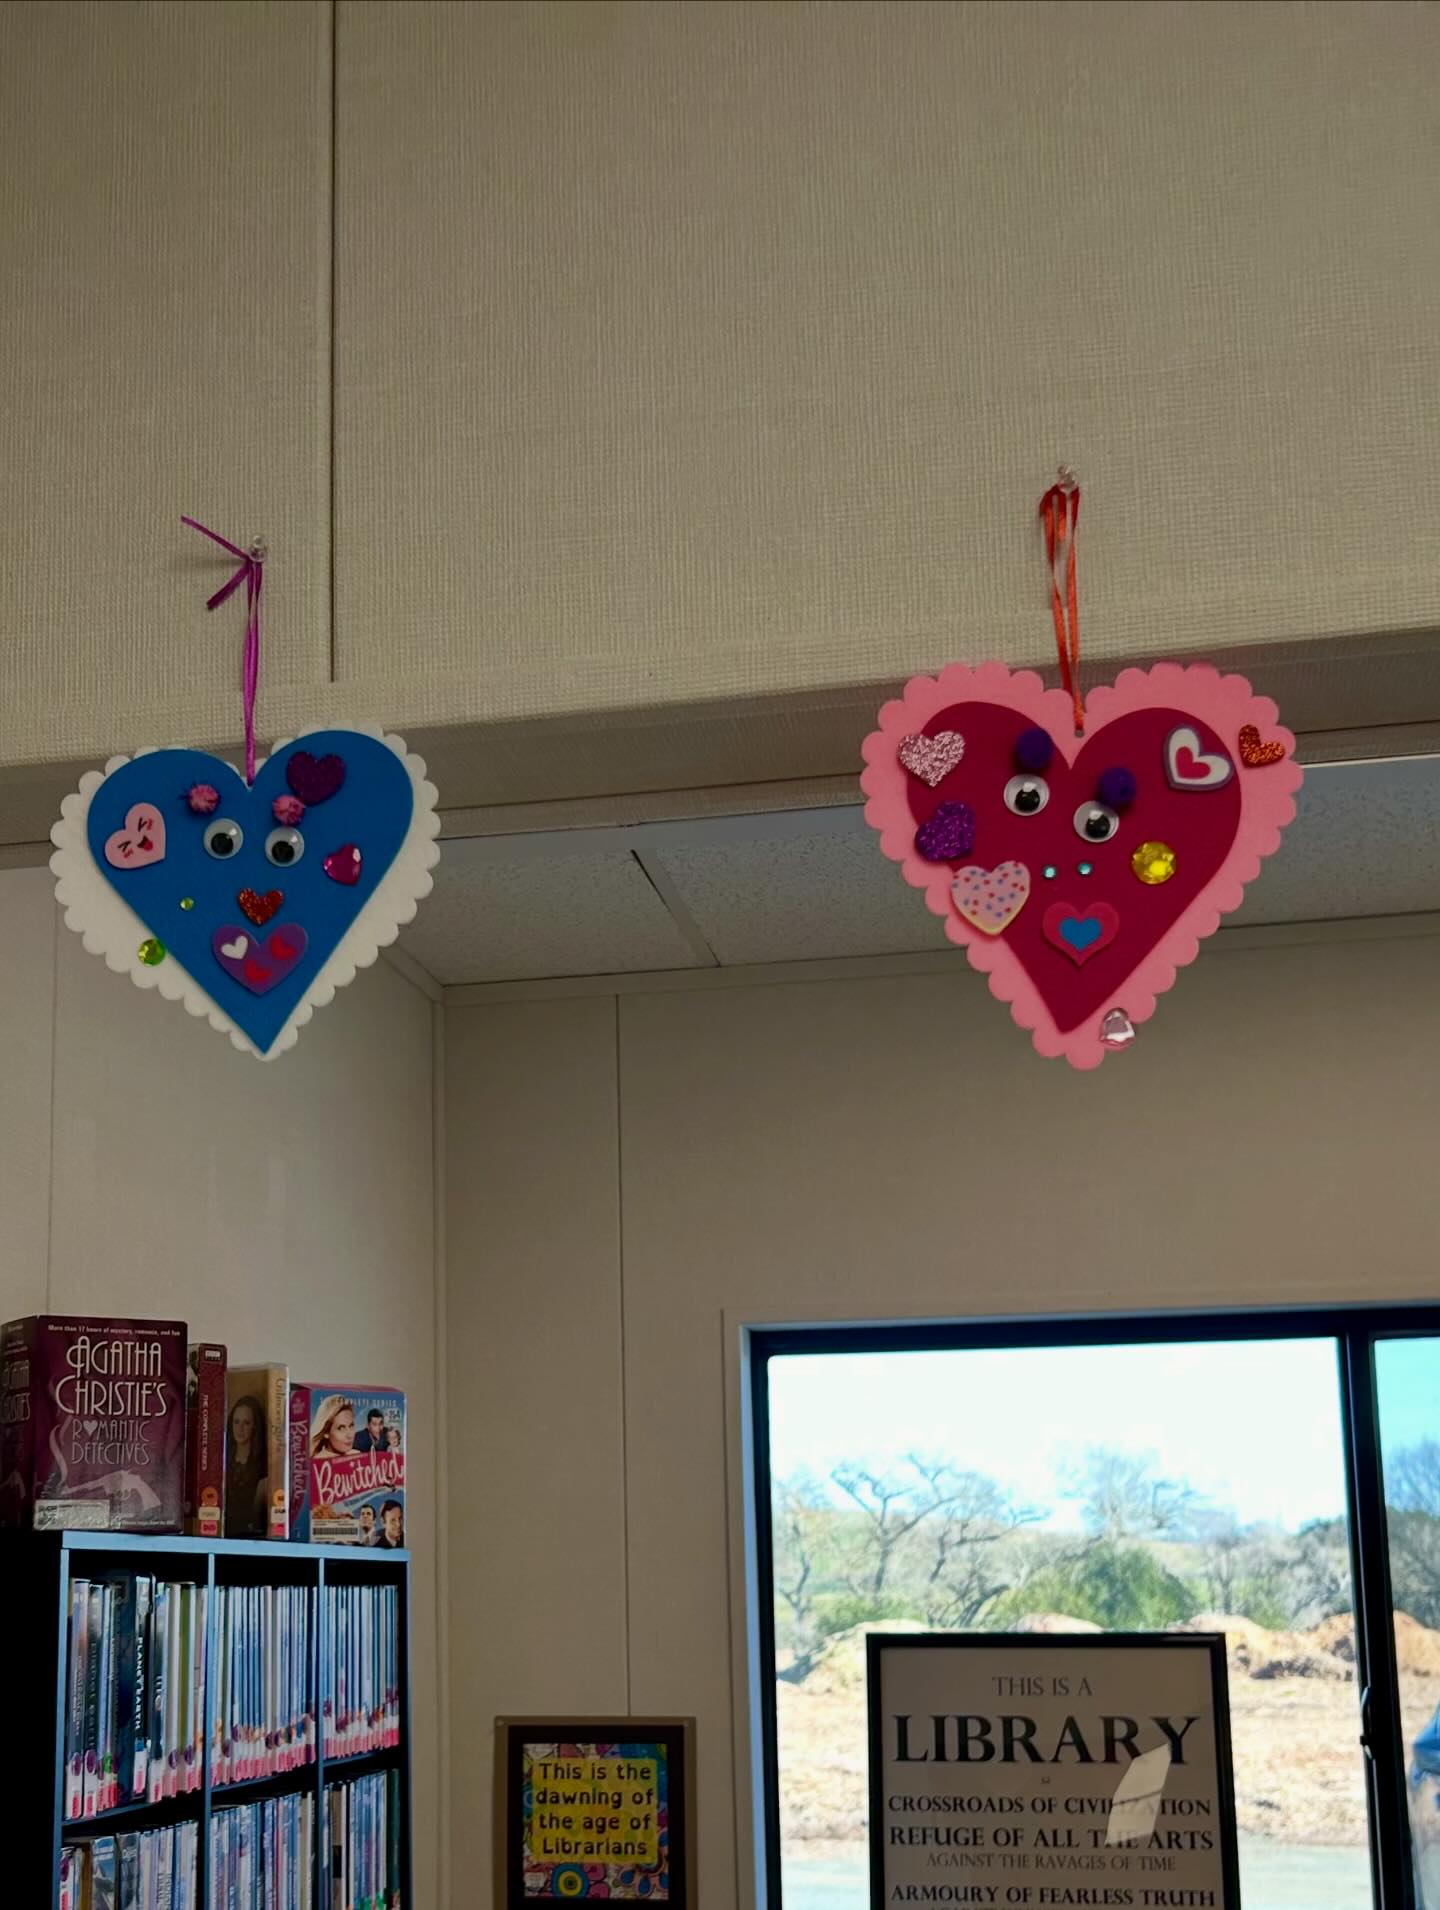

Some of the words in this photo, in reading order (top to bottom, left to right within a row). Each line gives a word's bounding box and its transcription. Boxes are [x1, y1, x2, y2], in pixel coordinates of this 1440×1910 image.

[48, 1324, 63, 1332] More
[66, 1335, 162, 1378] AGATHA
[55, 1374, 167, 1417] CHRISTIE'S
[72, 1442, 150, 1465] DETECTIVES
[290, 1419, 309, 1499] Bewitched
[313, 1443, 405, 1504] Bewitched
[992, 1676, 1044, 1697] THIS
[1052, 1676, 1070, 1697] IS
[1078, 1677, 1093, 1697] A
[892, 1714, 1201, 1765] LIBRARY
[539, 1763, 582, 1780] This
[591, 1763, 607, 1780] is
[616, 1763, 652, 1780] the
[536, 1787, 623, 1809] dawning
[631, 1788, 654, 1805] of
[888, 1795, 1024, 1814] CROSSROADS
[1031, 1796, 1058, 1815] OF
[539, 1812, 574, 1830] the
[583, 1816, 620, 1834] age
[630, 1813, 652, 1830] of
[542, 1837, 648, 1855] Librarians
[890, 1826, 985, 1847] REFUGE
[992, 1827, 1025, 1848] OF
[1033, 1827, 1080, 1848] ALL
[1149, 1829, 1214, 1850] ARTS
[926, 1853, 995, 1868] AGAINST
[997, 1853, 1031, 1869] THE
[1035, 1854, 1107, 1870] RAVAGES
[1110, 1854, 1132, 1870] OF
[1140, 1855, 1176, 1871] TIME
[891, 1885, 999, 1903] ARMOURY
[1006, 1886, 1032, 1904] OF
[1039, 1887, 1133, 1905] FEARLESS
[1139, 1889, 1215, 1907] TRUTH
